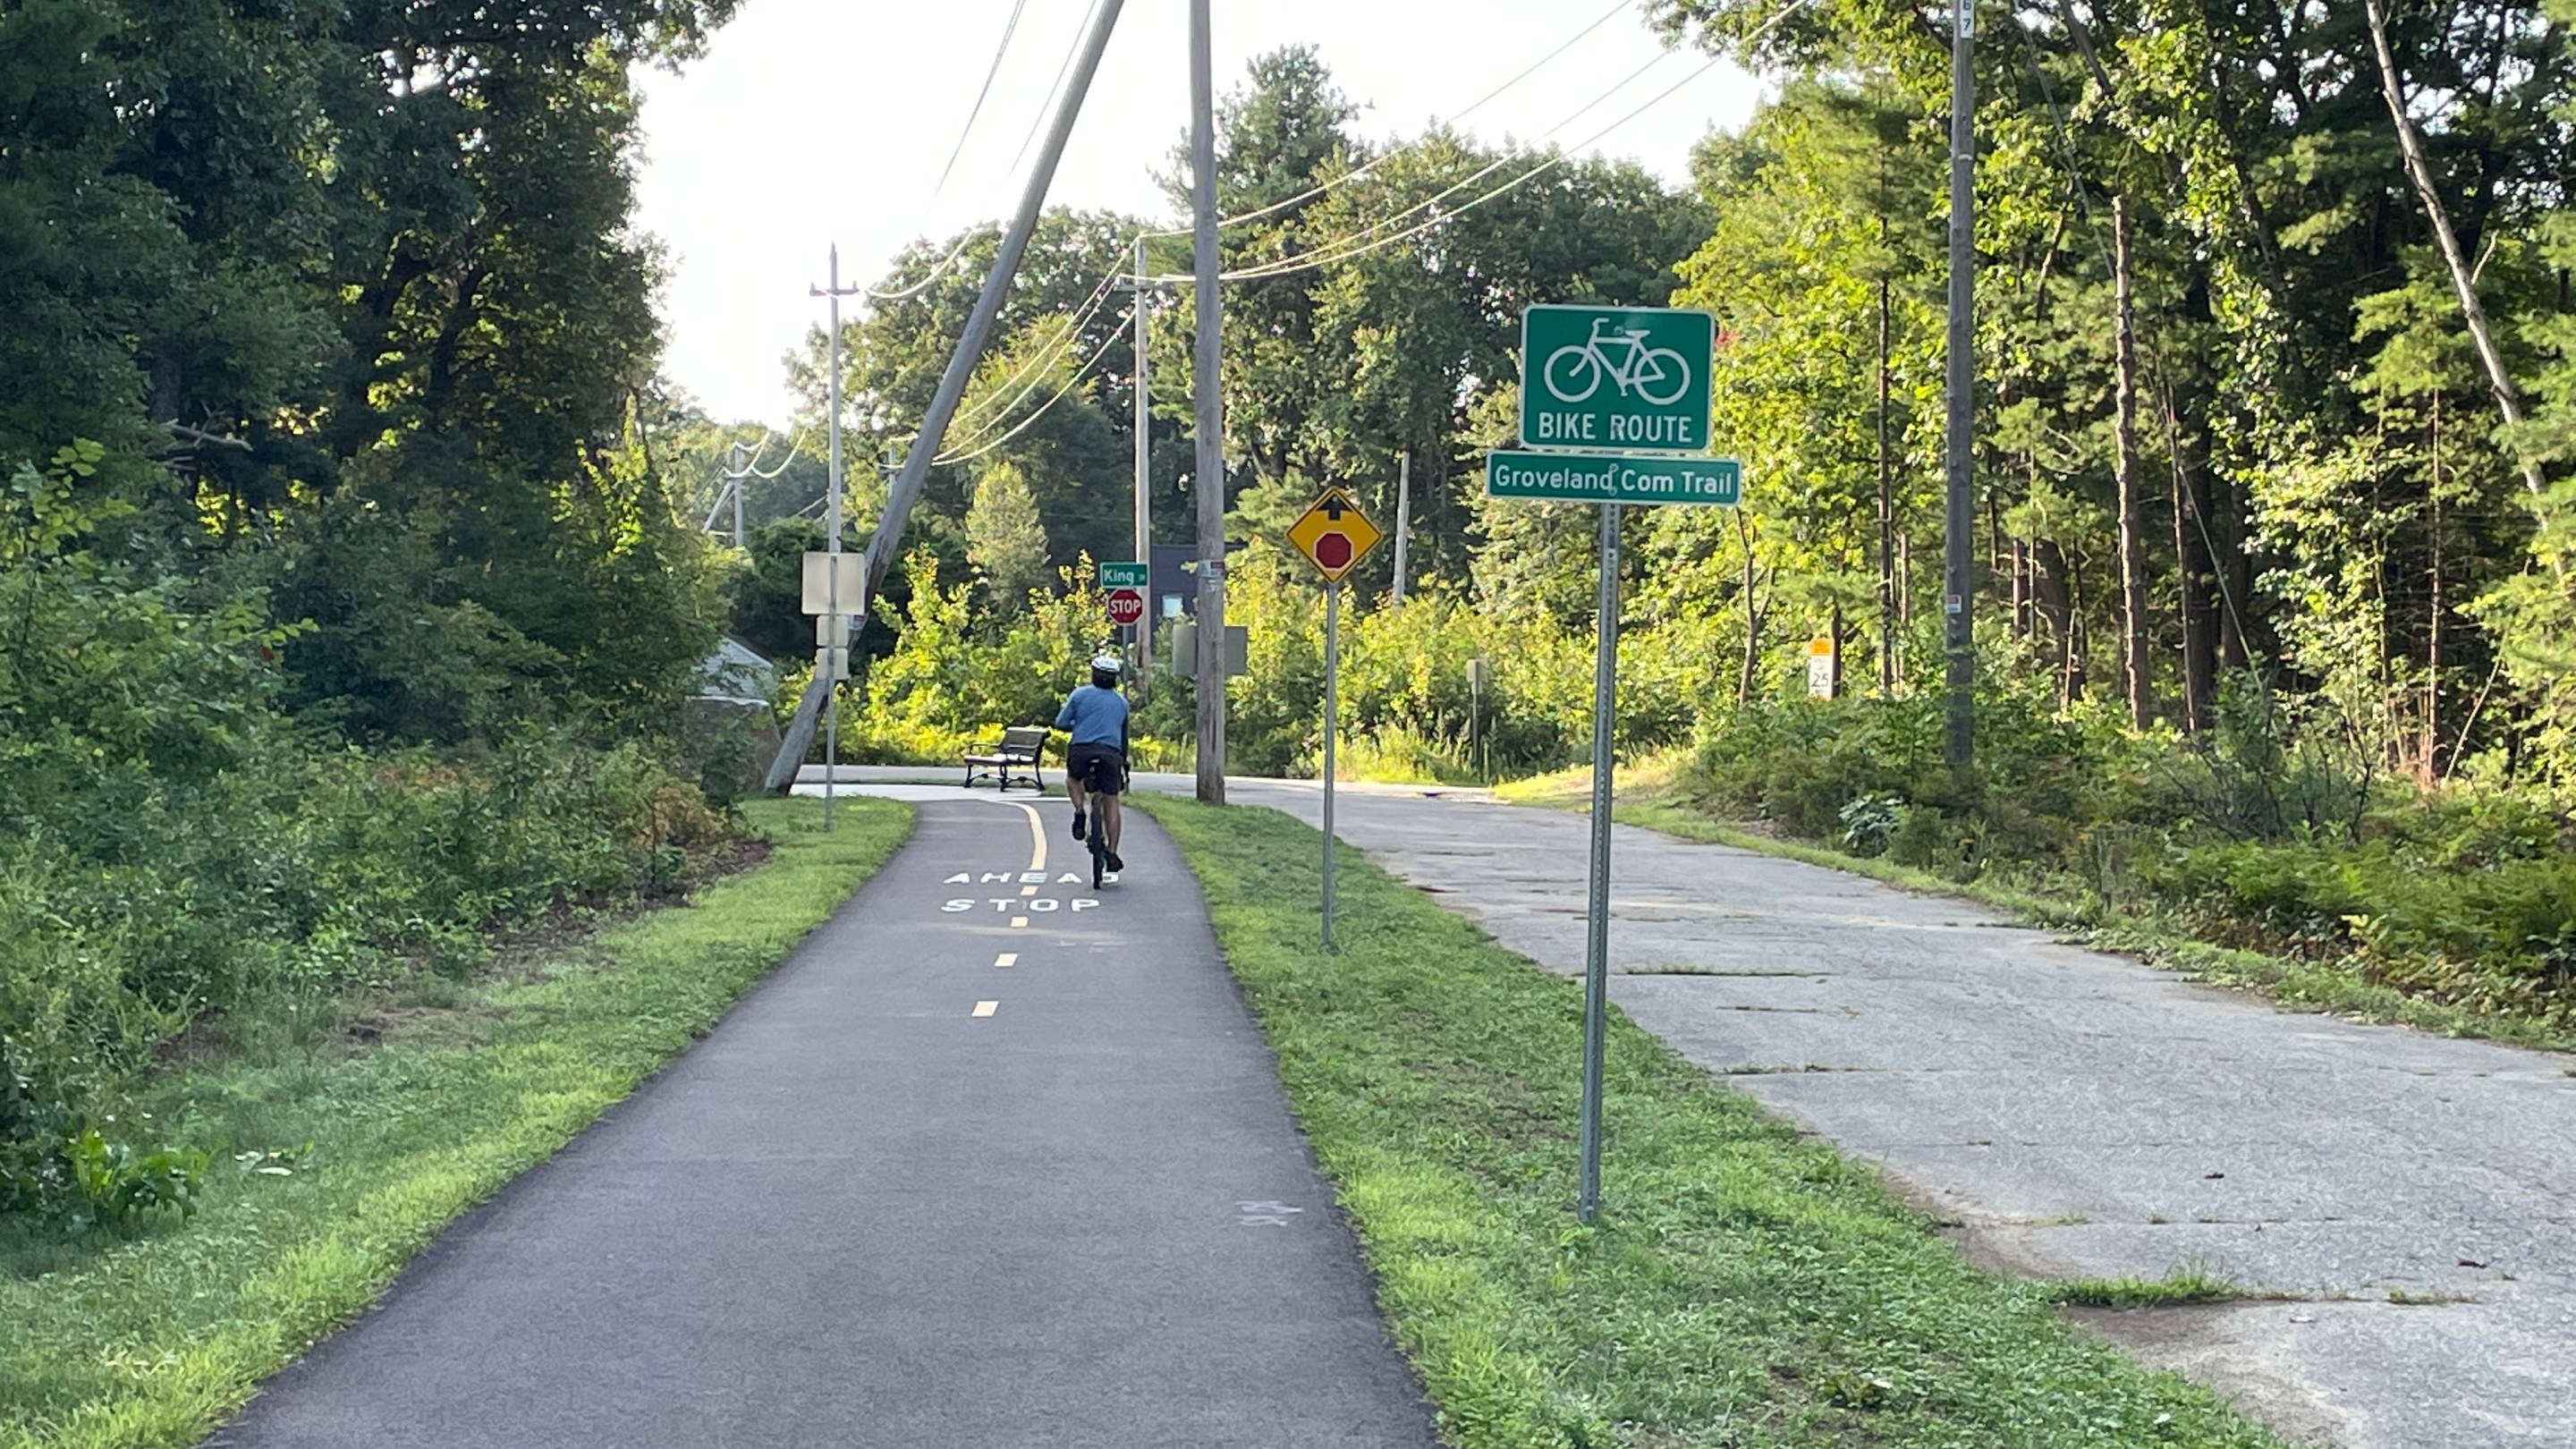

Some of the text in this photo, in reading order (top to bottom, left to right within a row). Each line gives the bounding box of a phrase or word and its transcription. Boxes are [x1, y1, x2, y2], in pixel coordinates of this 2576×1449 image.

[1538, 411, 1692, 443] BIKE ROUTE
[1495, 464, 1733, 496] Groveland Com Trail
[1104, 569, 1135, 586] King
[1109, 598, 1142, 614] STOP
[1810, 673, 1829, 688] 25
[943, 871, 1119, 885] AHEAD
[940, 898, 1100, 912] STOP
